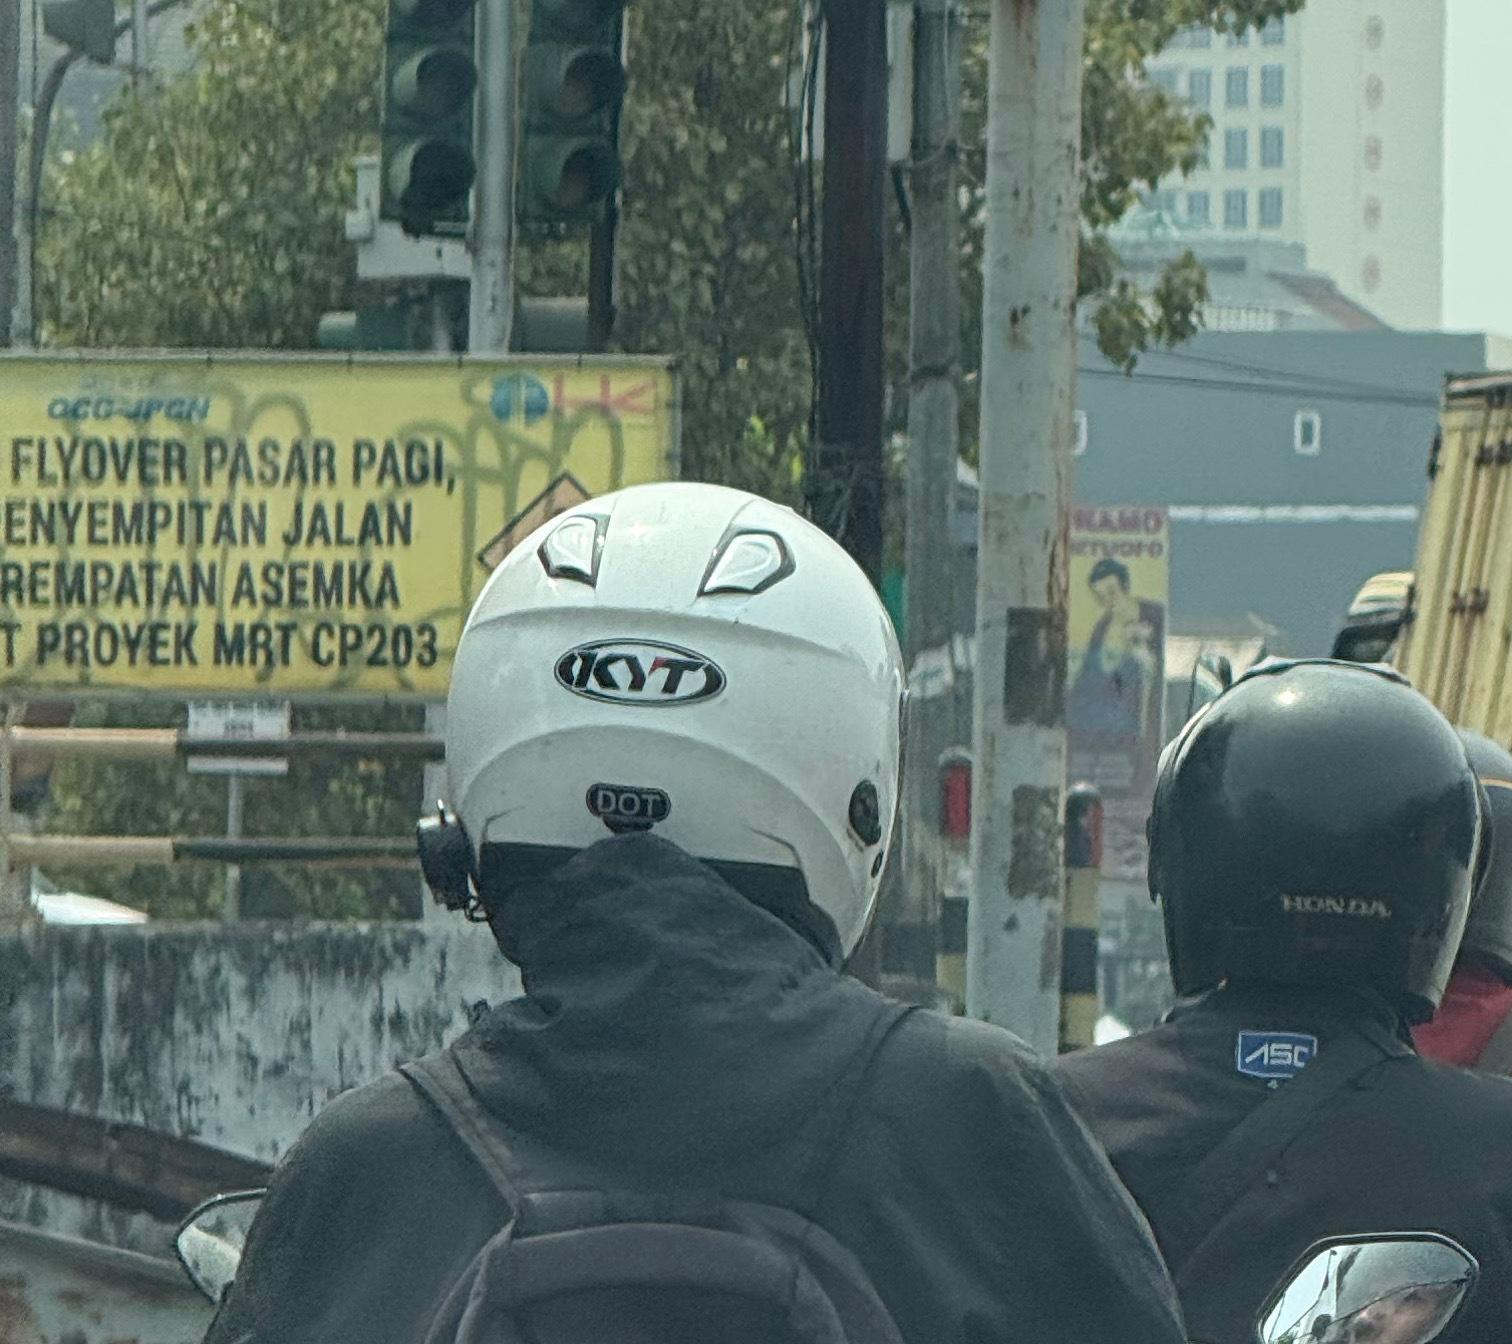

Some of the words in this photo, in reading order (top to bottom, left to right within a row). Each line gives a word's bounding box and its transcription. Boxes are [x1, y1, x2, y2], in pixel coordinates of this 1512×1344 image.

[10, 437, 188, 488] FLYOVER
[203, 438, 336, 488] PASAR
[352, 438, 456, 496] PAGI,
[3, 501, 268, 547] ENYEMPITAN
[282, 501, 414, 547] JALAN
[0, 560, 217, 608] REMPATAN
[231, 560, 400, 609] ASEMKA
[0, 622, 22, 667] T
[37, 622, 198, 667] PROYEK
[212, 622, 298, 669] MRT
[311, 622, 438, 668] CP203
[572, 651, 706, 695] KYT
[597, 790, 661, 816] DOT
[1281, 894, 1392, 919] HONDA
